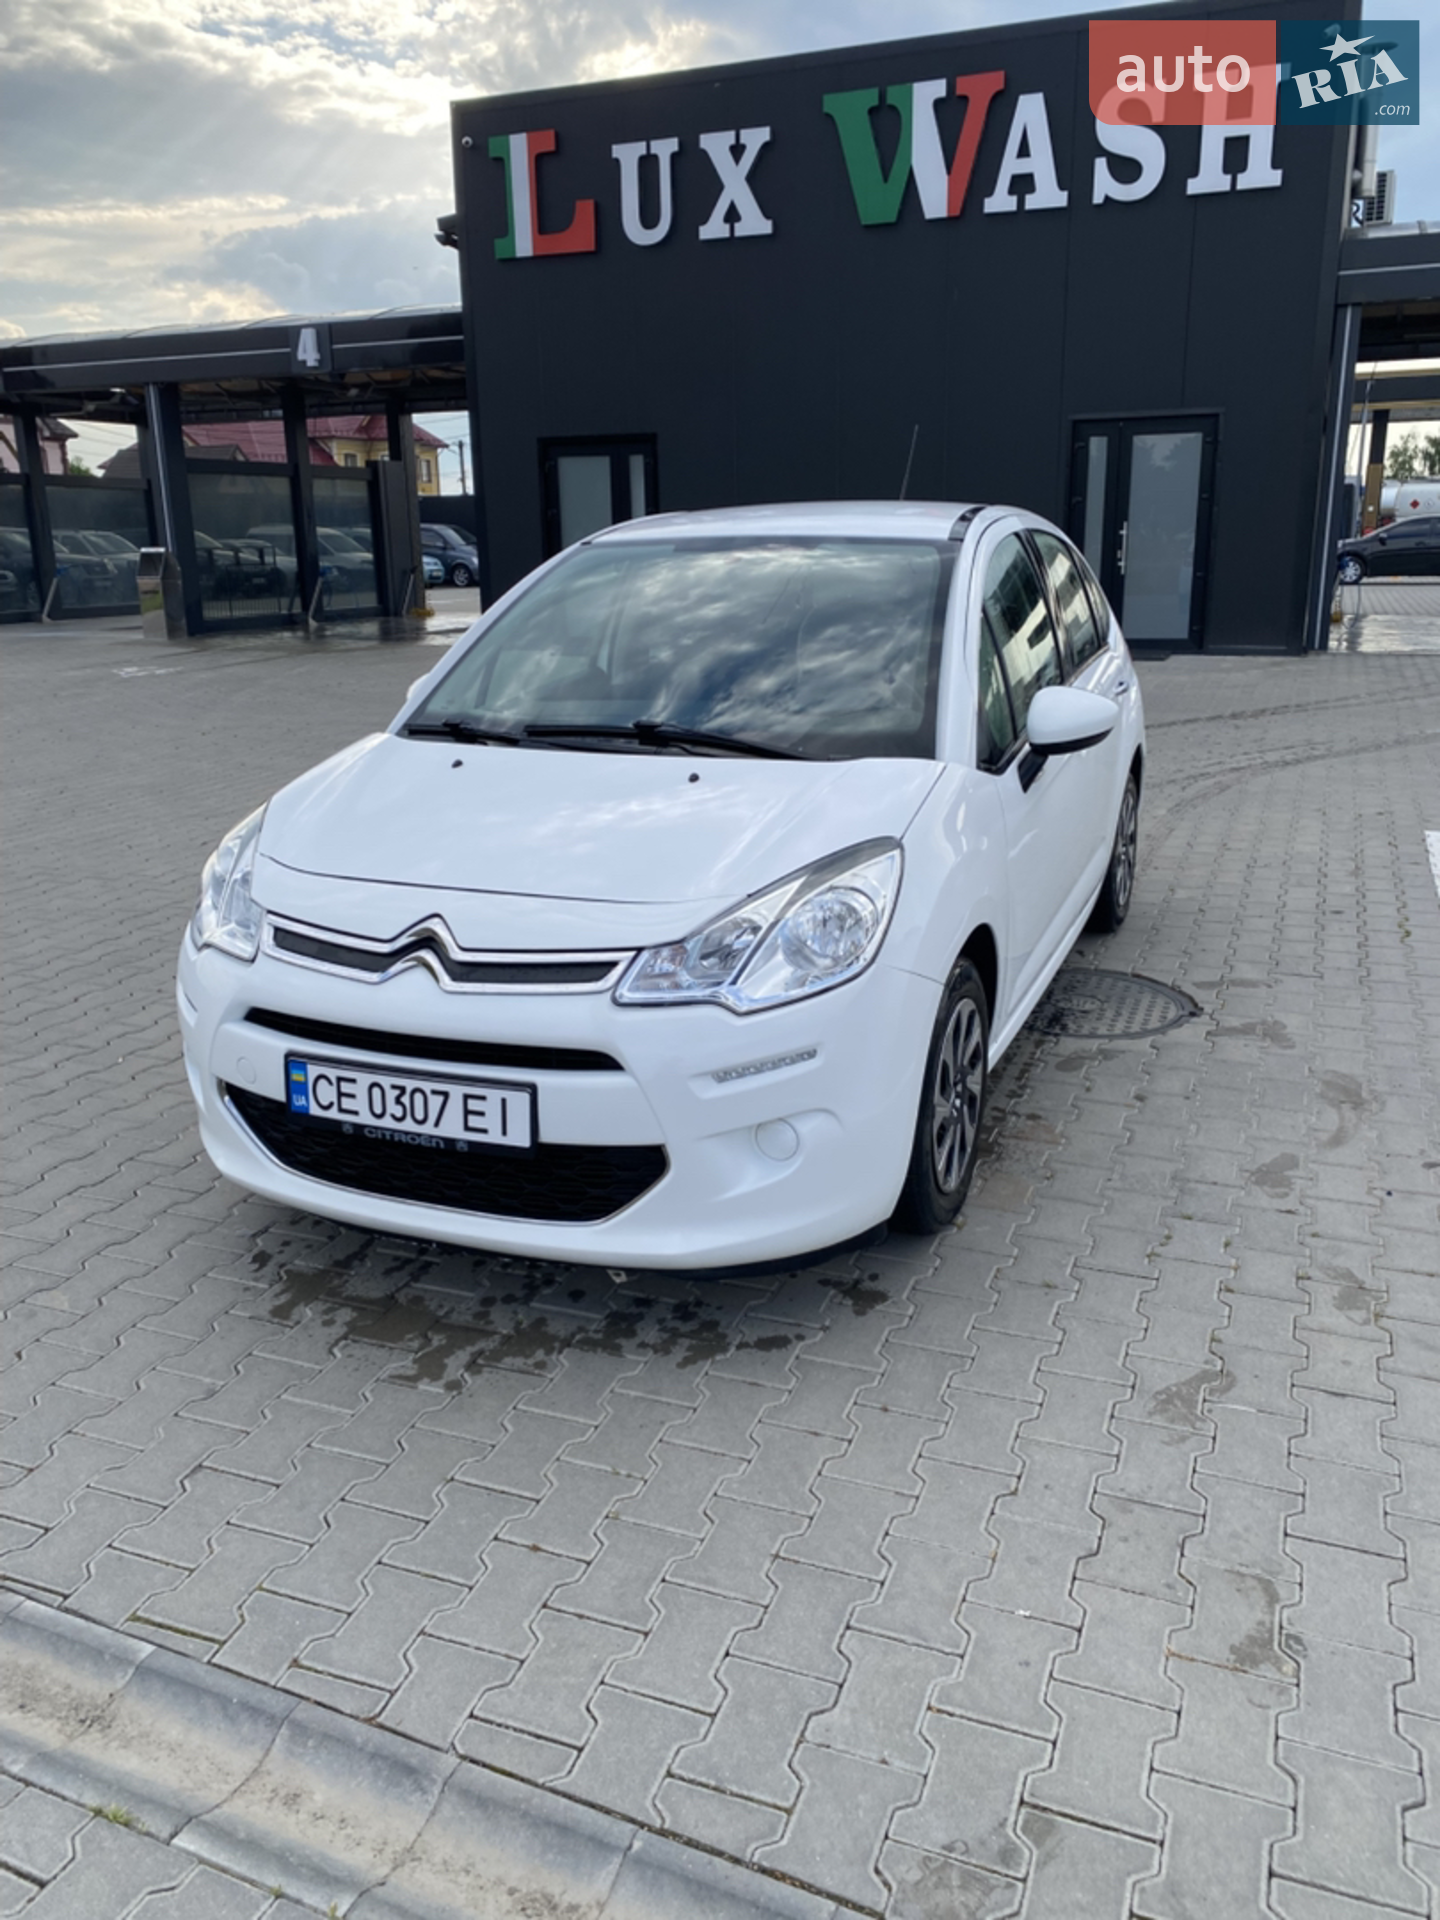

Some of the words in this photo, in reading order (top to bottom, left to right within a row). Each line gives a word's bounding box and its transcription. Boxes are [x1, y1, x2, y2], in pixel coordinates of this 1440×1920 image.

[488, 126, 773, 260] LUX
[822, 63, 1291, 226] WASH
[297, 327, 320, 367] 4
[292, 1094, 308, 1107] UA
[312, 1073, 360, 1117] CE
[367, 1082, 450, 1128] 0307
[462, 1093, 508, 1137] EI
